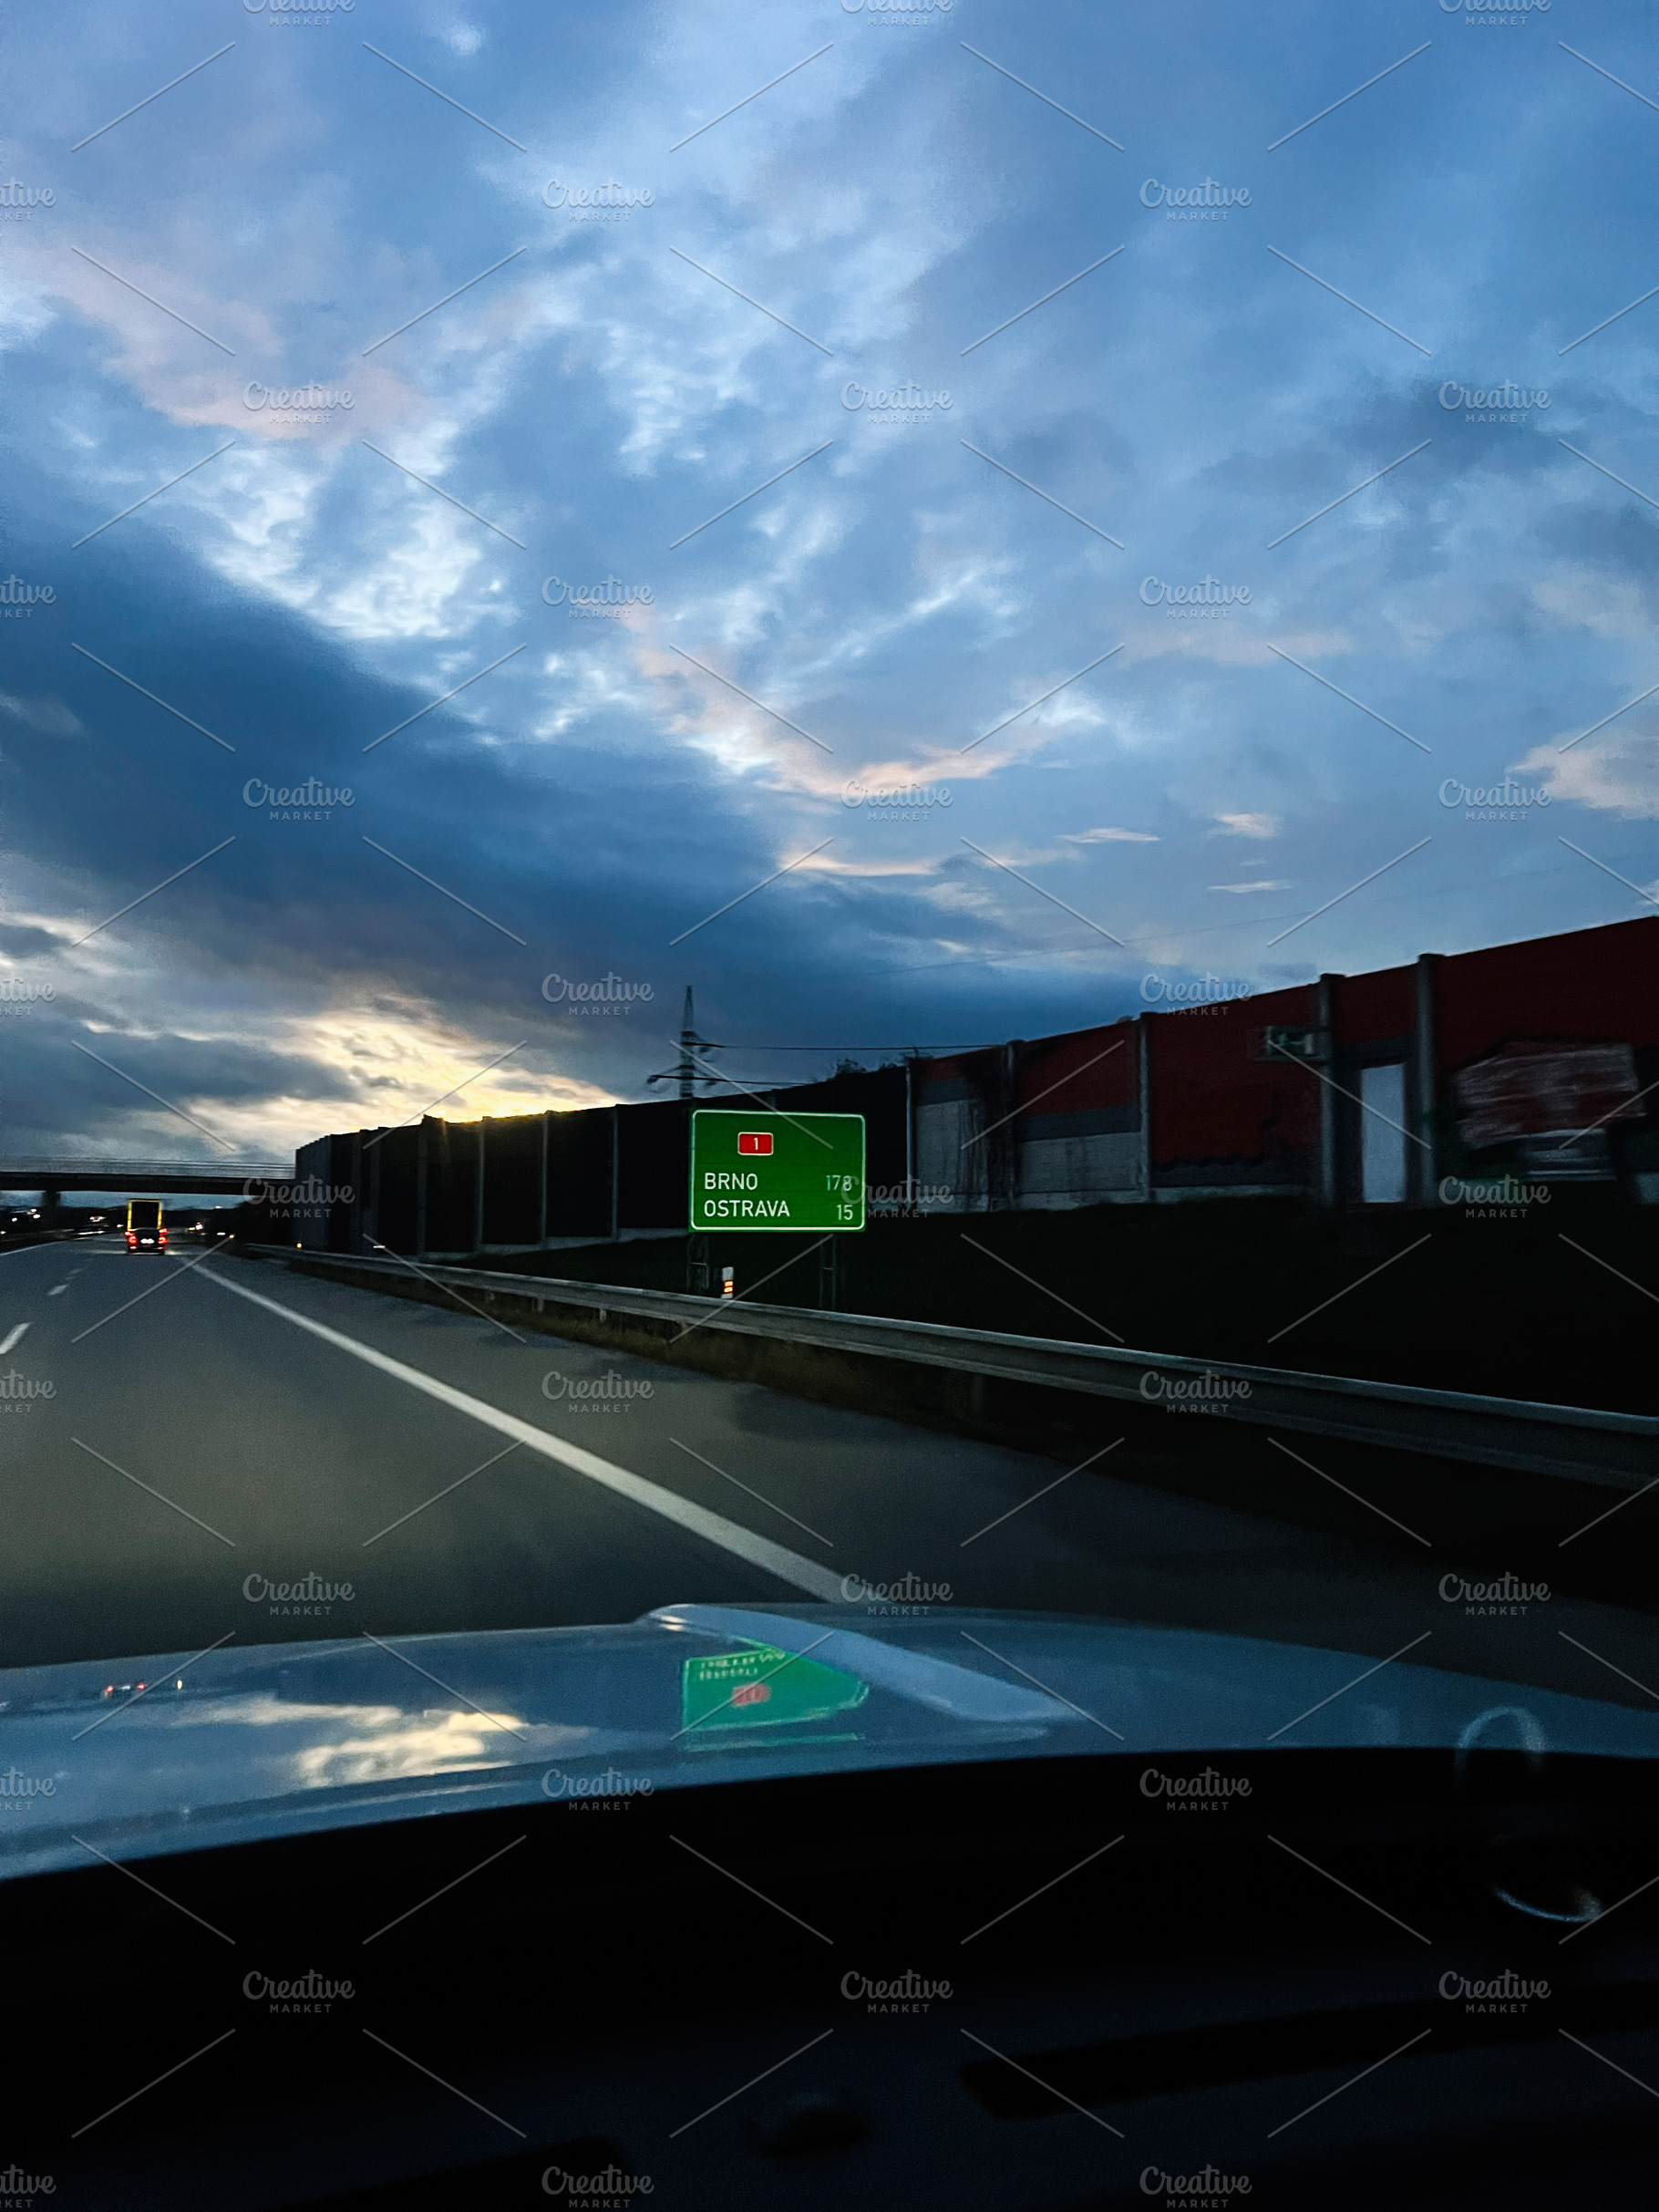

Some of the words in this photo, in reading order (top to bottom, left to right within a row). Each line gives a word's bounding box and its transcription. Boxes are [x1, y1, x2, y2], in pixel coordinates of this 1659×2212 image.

[753, 1137, 759, 1151] 1
[704, 1173, 758, 1190] BRNO
[826, 1174, 852, 1192] 178
[704, 1200, 790, 1217] OSTRAVA
[836, 1204, 853, 1220] 15
